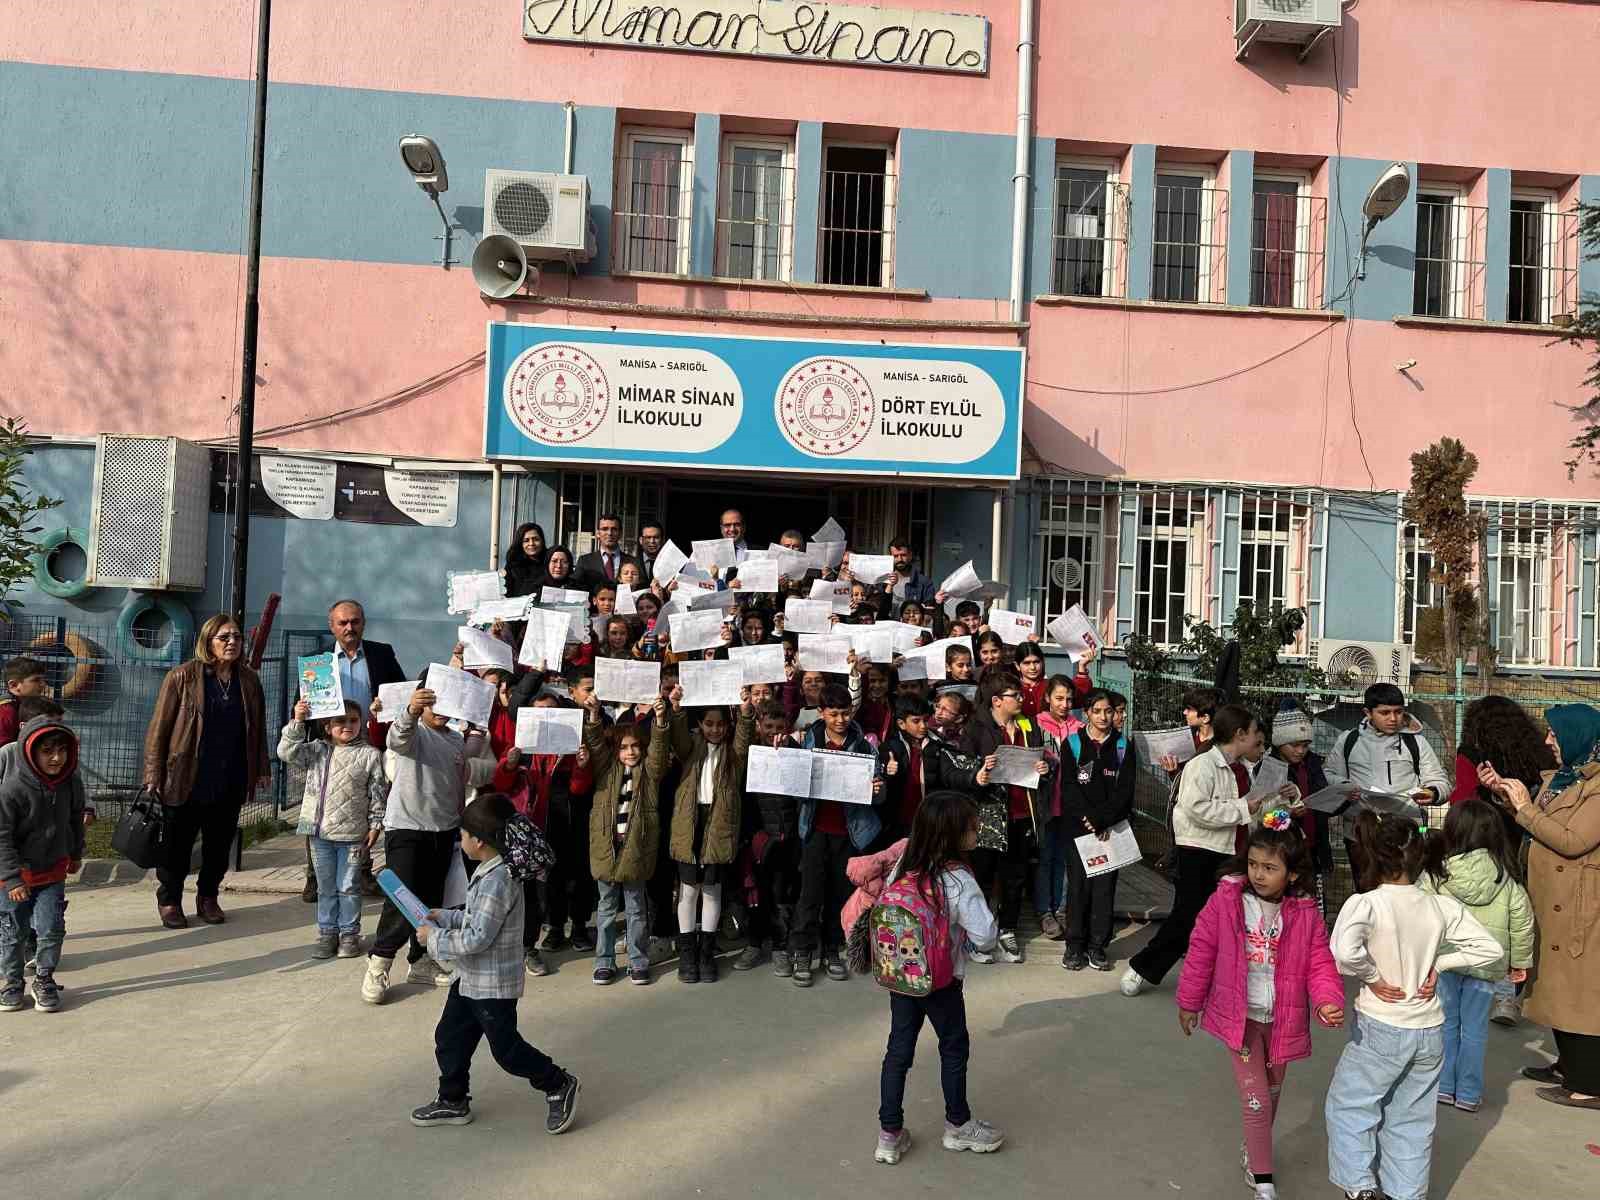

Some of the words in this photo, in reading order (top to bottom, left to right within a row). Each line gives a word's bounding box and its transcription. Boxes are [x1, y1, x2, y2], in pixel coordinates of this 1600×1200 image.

[619, 358, 657, 369] MANİSA
[666, 361, 708, 372] SARIGÖL
[883, 371, 919, 382] MANİSA
[929, 373, 968, 384] SARIGÖL
[618, 383, 676, 404] MİMAR
[681, 387, 735, 406] SİNAN
[617, 405, 702, 427] İLKOKULU
[882, 396, 925, 415] DÖRT
[930, 399, 982, 417] EYLÜL
[881, 418, 962, 438] İLKOKULU
